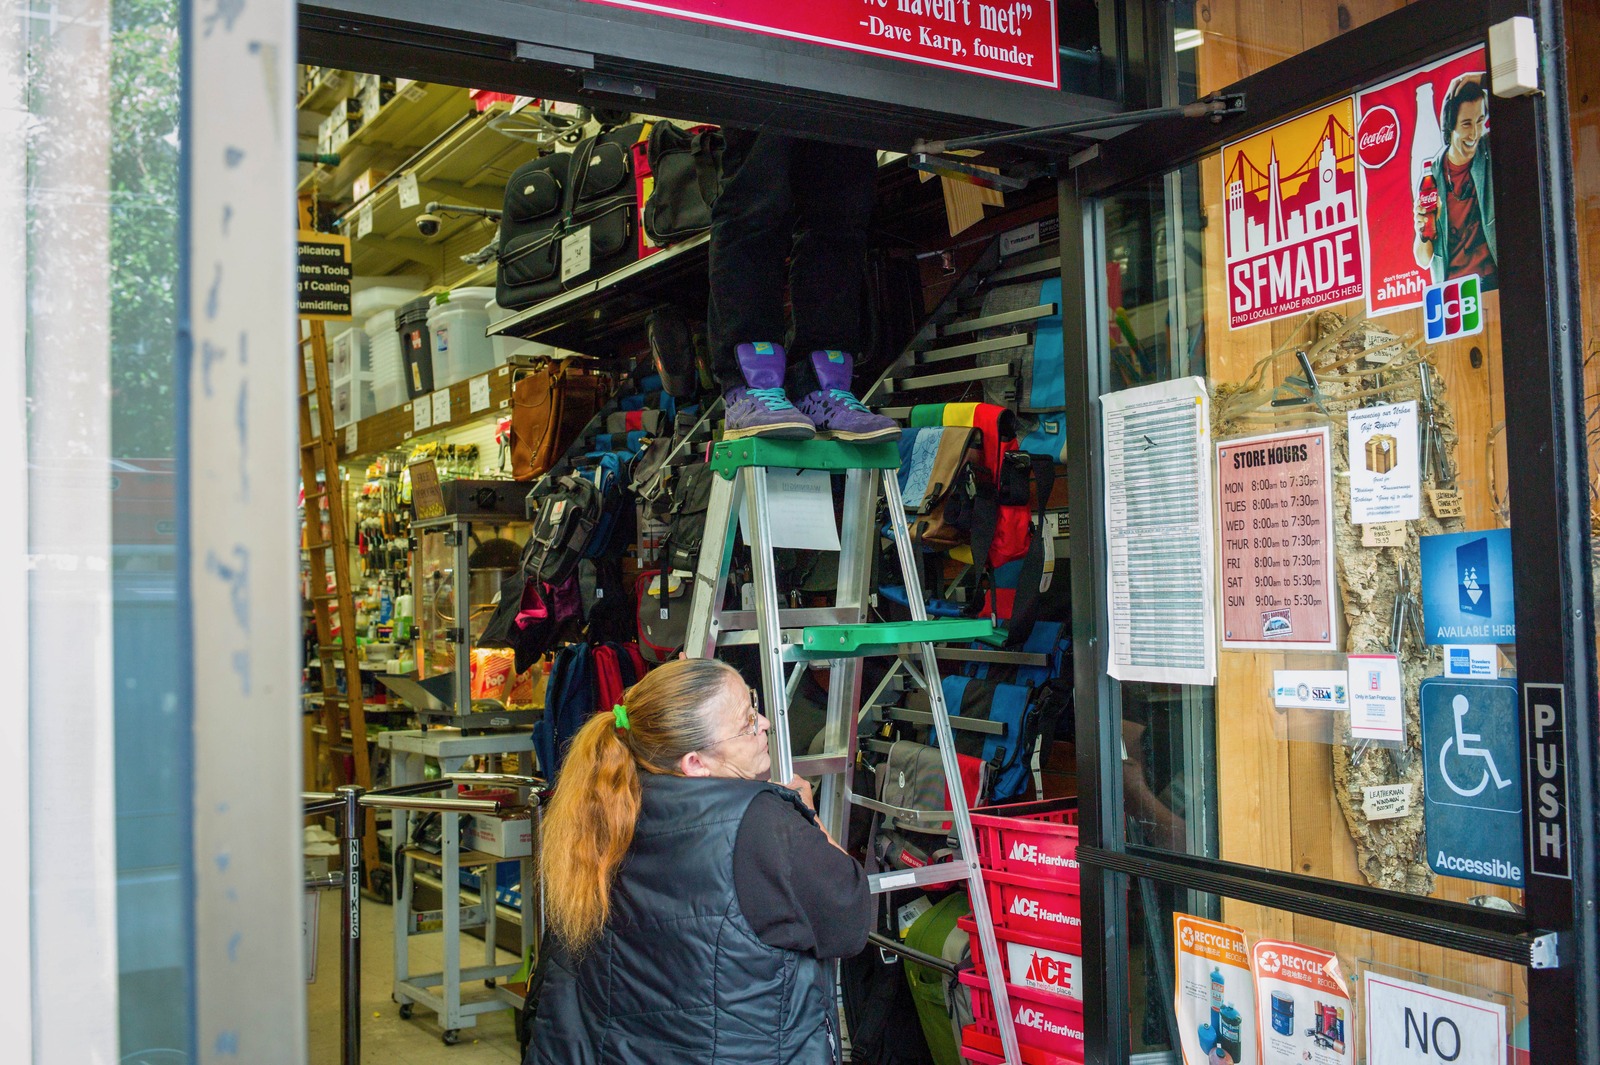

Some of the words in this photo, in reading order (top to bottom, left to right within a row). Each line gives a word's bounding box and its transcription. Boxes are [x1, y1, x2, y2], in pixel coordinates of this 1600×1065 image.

[919, 26, 967, 58] Karp,
[973, 38, 1034, 67] founder
[322, 265, 349, 276] Tools
[1234, 232, 1355, 314] SFMADE
[1396, 272, 1410, 280] forget
[310, 282, 350, 294] Coating
[1232, 312, 1248, 325] FIND
[1250, 303, 1278, 320] LOCALLY
[1279, 298, 1300, 314] MADE
[1302, 289, 1340, 308] PRODUCTS
[1340, 283, 1362, 298] HERE
[1427, 295, 1477, 323] JCB
[1350, 412, 1381, 421] Announcing
[1392, 406, 1411, 415] Urban
[1361, 422, 1372, 433] Gift
[1233, 448, 1266, 470] STORE
[1268, 444, 1308, 465] HOURS
[1225, 482, 1244, 493] MON
[1251, 479, 1278, 491] 8:00am
[1279, 479, 1287, 489] to
[1225, 501, 1247, 512] TUES
[1252, 498, 1278, 510] 8:00am
[1280, 499, 1288, 508] to
[1226, 520, 1245, 532] WED
[1252, 518, 1280, 529] 8:00am
[1281, 518, 1289, 528] to
[1226, 539, 1250, 550] THUR
[1253, 537, 1280, 549] 8:00am
[1282, 538, 1290, 547] to
[1227, 558, 1240, 569] FRI
[1254, 556, 1281, 568] 8:00am
[1282, 557, 1290, 566] to
[1228, 576, 1243, 588] SAT
[1254, 575, 1282, 587] 9:00am
[1283, 577, 1291, 586] to
[1228, 596, 1245, 607] SUN
[1255, 595, 1282, 607] 9:00am
[1284, 596, 1292, 606] to
[1437, 626, 1490, 638] AVAILABLE
[1312, 689, 1331, 699] SBA
[1534, 704, 1561, 859] PUSH
[1370, 786, 1404, 799] LEATHERMAN
[351, 840, 358, 866] NO
[1009, 840, 1037, 865] ACE
[1038, 852, 1080, 869] Hardwar
[1435, 850, 1521, 881] Accessible
[1010, 895, 1038, 920] ACE
[1040, 908, 1082, 927] Hardwar
[1194, 930, 1230, 950] RECYCLE
[1026, 950, 1072, 990] ACE
[1282, 954, 1323, 975] RECYCLE
[1026, 979, 1036, 987] The
[1014, 1005, 1043, 1031] ACE
[1404, 1006, 1461, 1062] NO
